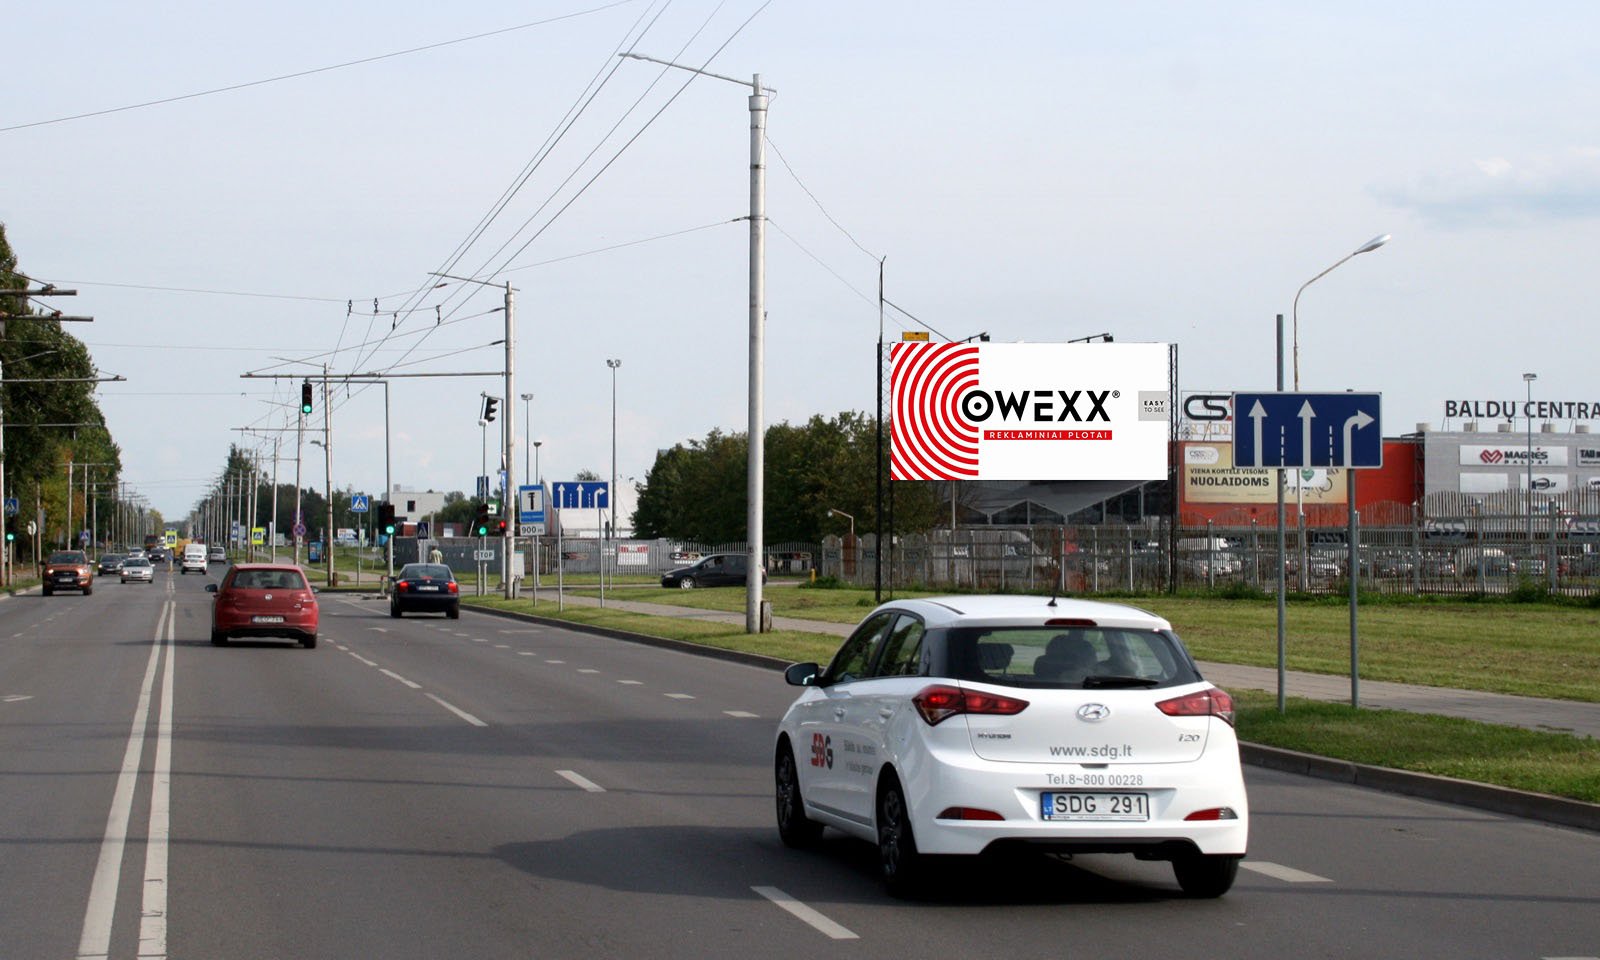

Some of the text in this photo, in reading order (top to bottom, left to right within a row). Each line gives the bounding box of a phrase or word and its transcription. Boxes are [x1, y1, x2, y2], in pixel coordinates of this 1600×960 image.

[1446, 400, 1516, 423] BALDŲ
[989, 431, 1107, 439] REKLAMINIAI PLOTAI
[1190, 477, 1270, 487] NUOLAIDOMS
[521, 526, 537, 534] 900
[1178, 733, 1200, 742] i20
[1050, 744, 1133, 759] www.sdg.lt
[1108, 774, 1143, 786] 00228
[1055, 795, 1143, 814] SDG 291
